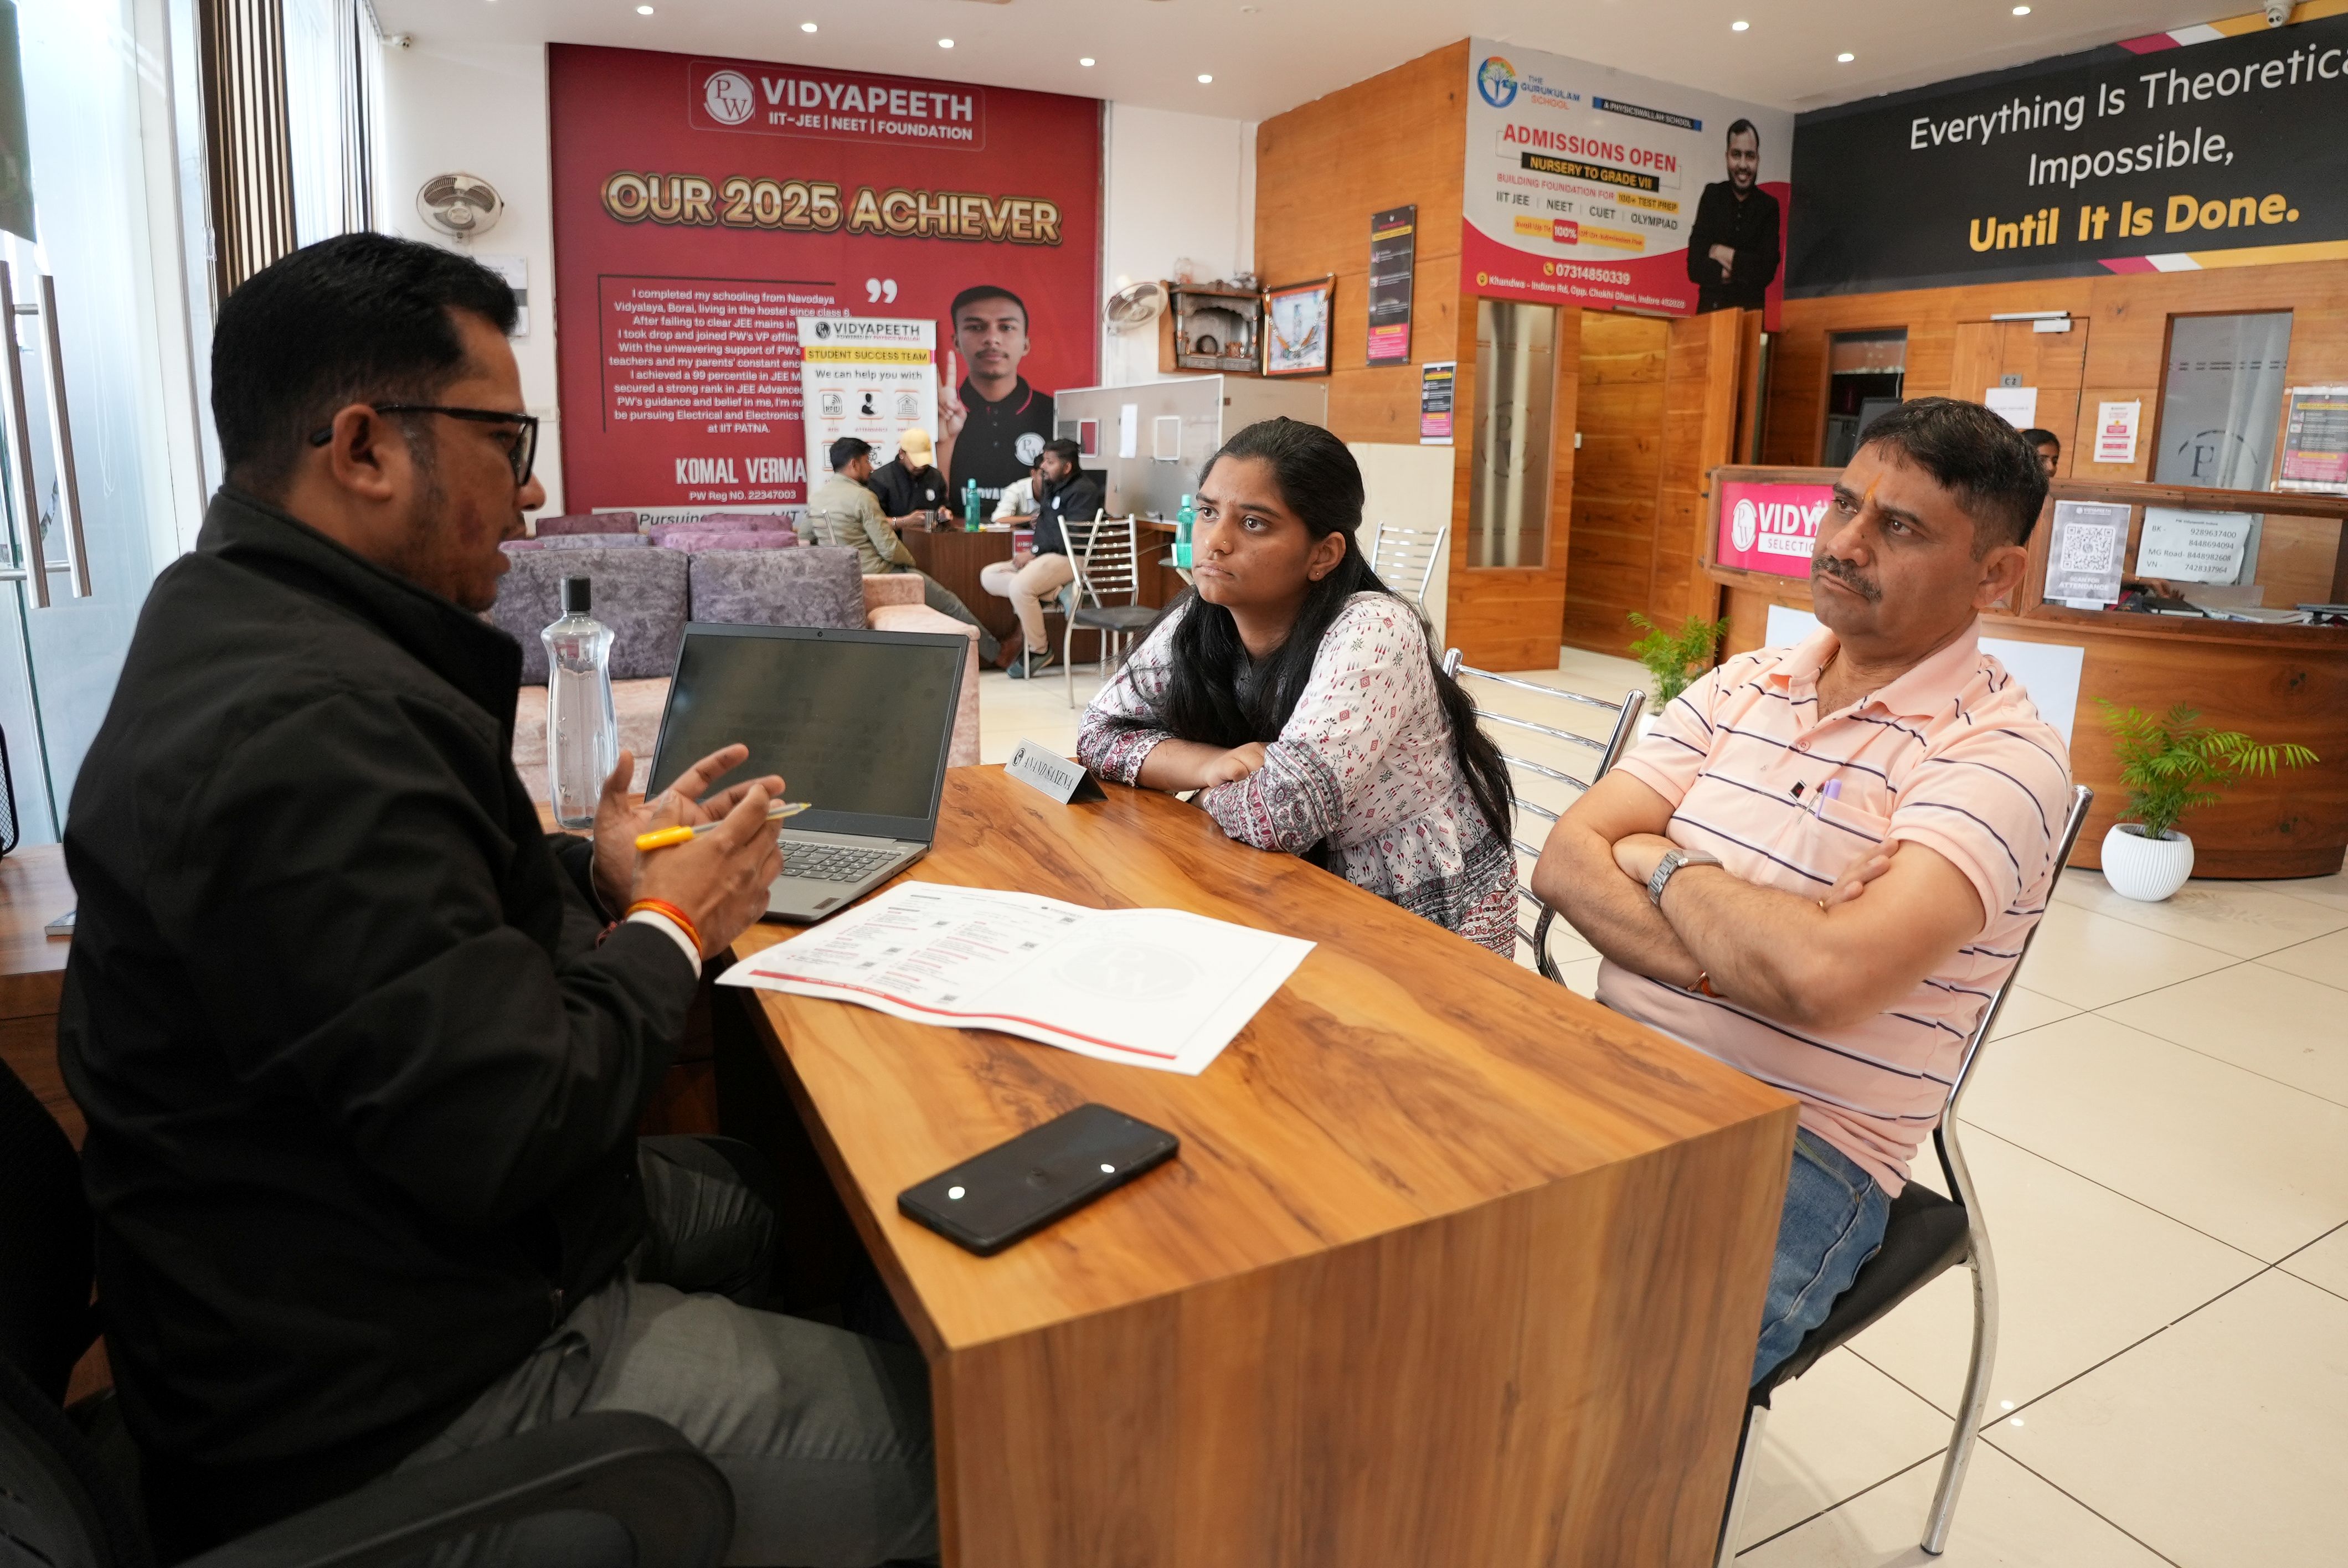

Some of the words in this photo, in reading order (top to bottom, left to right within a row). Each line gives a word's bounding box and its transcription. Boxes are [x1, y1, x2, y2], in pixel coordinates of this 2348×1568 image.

[760, 76, 973, 122] VIDYAPEETH
[1521, 82, 1580, 101] GURUKULAM
[1531, 95, 1569, 110] SCHOOL
[1910, 93, 2086, 151] Everything
[2098, 84, 2126, 118] Is
[769, 111, 821, 128] IIT-JEE
[832, 118, 867, 132] NEET
[878, 120, 973, 141] FOUNDATION
[1503, 123, 1625, 162] ADMISSIONS
[1629, 148, 1677, 173] OPEN
[2027, 126, 2235, 190] Impossible,
[1530, 156, 1583, 176] NURSERY
[1584, 167, 1598, 180] TO
[1600, 168, 1638, 187] GRADE
[1497, 172, 1540, 188] BUILDING
[1541, 179, 1595, 198] FOUNDATION
[1598, 190, 1615, 200] FOR
[1638, 197, 1656, 208] TEST
[1657, 199, 1678, 212] PREP
[604, 173, 715, 223] OUR
[721, 178, 842, 230] 2025
[849, 189, 1062, 244] ACHIEVER
[1496, 190, 1510, 203] IIT
[1511, 193, 1530, 207] JEE
[1546, 199, 1573, 213] NEET
[1589, 205, 1615, 220] CUET
[1630, 212, 1678, 230] OLYMPIAD
[1969, 207, 2059, 252] Until
[2078, 205, 2109, 243] It
[2119, 200, 2154, 238] Is
[2165, 193, 2300, 234] Done.
[1554, 225, 1578, 240] 100%
[1556, 262, 1631, 286] 07314850339
[638, 288, 692, 301] completed
[695, 291, 710, 302] my
[712, 290, 760, 303] schooling
[762, 292, 785, 303] from
[787, 292, 835, 306] Navodaya
[1531, 280, 1556, 293] Indore
[1638, 295, 1660, 306] Indore
[698, 303, 726, 316] living
[727, 304, 737, 314] in
[739, 305, 755, 314] the
[757, 306, 787, 315] hostel
[789, 306, 815, 317] since
[817, 307, 841, 317] class
[634, 316, 658, 326] After
[661, 316, 692, 328] failing
[694, 318, 705, 327] to
[707, 317, 732, 327] clear
[733, 318, 753, 328] JEE
[754, 319, 784, 329] mains
[786, 319, 796, 329] in
[833, 323, 920, 336] VIDYAPEETH
[624, 329, 648, 339] took
[650, 329, 673, 341] drop
[675, 329, 694, 340] and
[696, 330, 727, 342] joined
[729, 331, 753, 342] PW's
[755, 332, 770, 342] VP
[617, 342, 643, 352] With
[645, 343, 662, 353] the
[664, 343, 723, 355] unwavering
[724, 345, 763, 357] support
[765, 345, 775, 355] of
[776, 345, 801, 355] PW's
[807, 350, 852, 360] STUDENT
[855, 351, 899, 360] SUCCESS
[902, 352, 928, 361] TEAM
[609, 355, 654, 366] teachers
[656, 356, 675, 366] and
[678, 358, 693, 368] my
[738, 359, 781, 368] constant
[636, 369, 682, 380] achieved
[683, 372, 691, 380] a
[692, 370, 706, 380] 99
[708, 370, 757, 382] percentile
[759, 371, 769, 381] in
[770, 372, 789, 381] JEE
[815, 369, 831, 378] We
[835, 370, 852, 379] can
[855, 369, 876, 381] help
[880, 372, 898, 381] you
[901, 370, 923, 380] with
[613, 383, 655, 393] secured
[657, 385, 664, 393] a
[665, 384, 698, 395] strong
[701, 383, 723, 393] rank
[725, 384, 734, 394] in
[736, 384, 756, 394] JEE
[617, 396, 642, 406] PW's
[645, 396, 691, 408] guidance
[693, 396, 712, 406] and
[714, 396, 742, 407] belief
[744, 397, 753, 407] in
[756, 399, 773, 408] me,
[614, 410, 627, 420] be
[630, 410, 674, 421] pursuing
[677, 410, 723, 420] Electrical
[724, 410, 743, 420] and
[746, 410, 799, 420] Electronics
[707, 424, 718, 433] at
[720, 423, 732, 432] IIT
[734, 423, 770, 433] PATNA.
[675, 457, 739, 484] KOMAL
[745, 457, 807, 484] VERMA
[689, 491, 707, 501] PW
[709, 491, 728, 503] Reg
[748, 489, 796, 501] 22347003
[639, 512, 705, 526] Pursuin
[2149, 548, 2161, 556] MG
[2058, 582, 2109, 591] ATTENDANCE
[1023, 755, 1047, 775] ANAND
[1044, 766, 1073, 791] SAXENA
